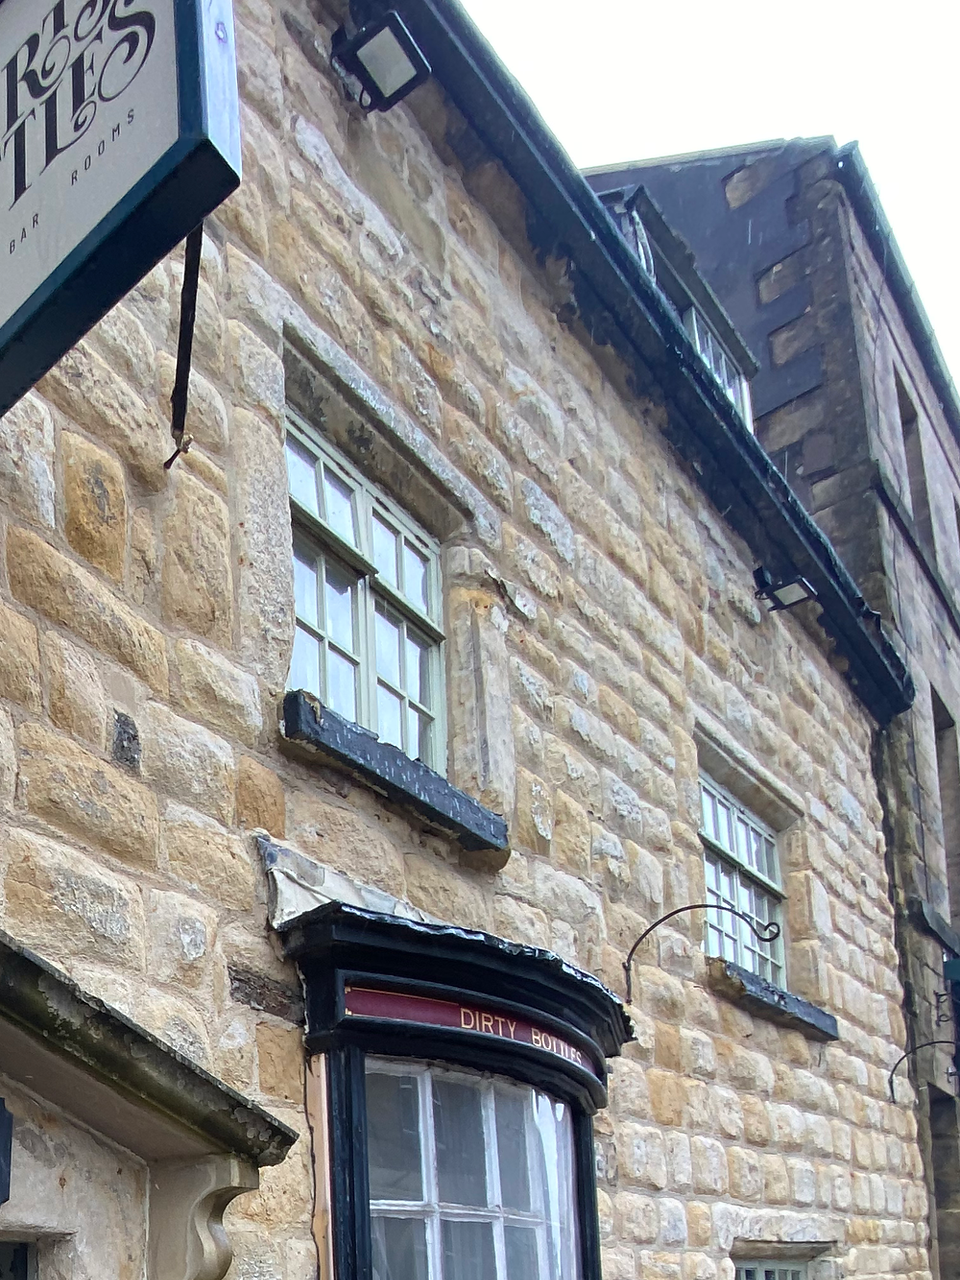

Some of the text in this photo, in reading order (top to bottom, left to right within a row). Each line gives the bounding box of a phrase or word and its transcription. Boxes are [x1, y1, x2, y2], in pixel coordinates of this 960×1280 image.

[9, 213, 39, 254] BAR
[71, 108, 134, 186] ROOMS
[460, 1007, 582, 1065] DIRTY BOTTLES
